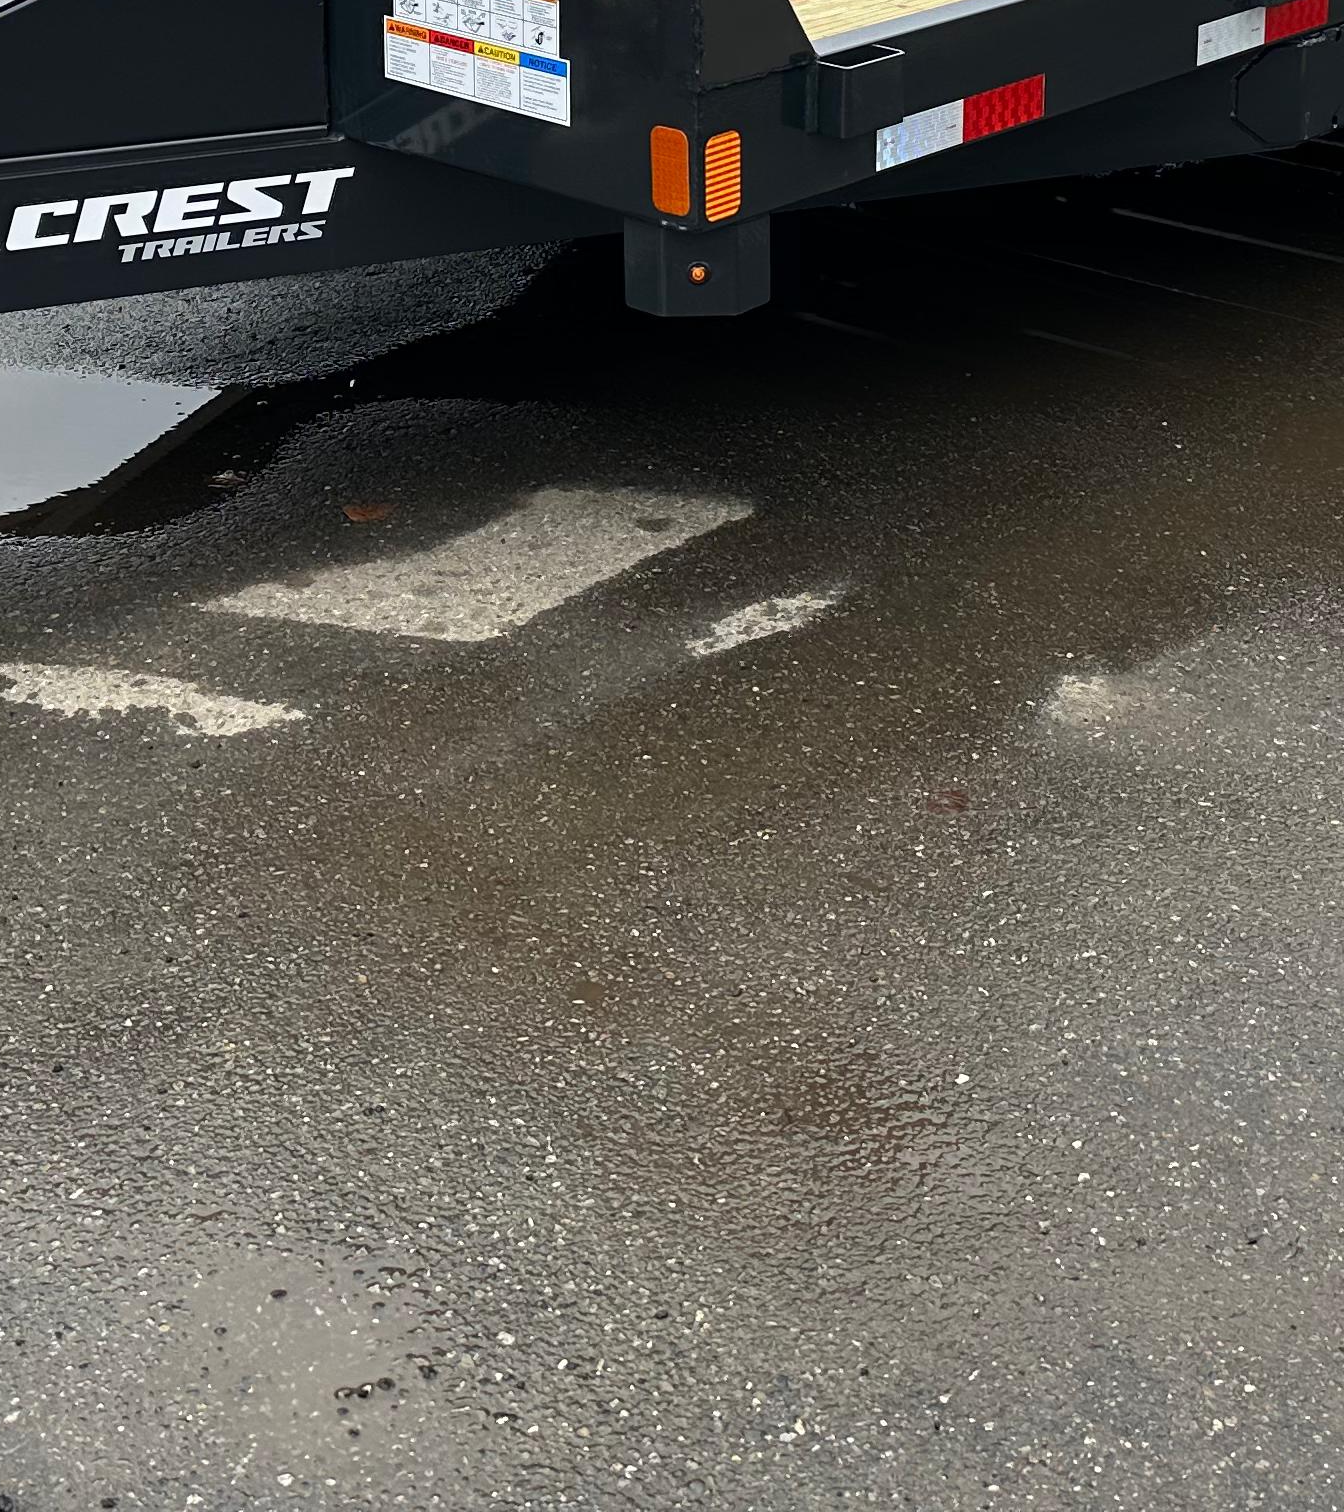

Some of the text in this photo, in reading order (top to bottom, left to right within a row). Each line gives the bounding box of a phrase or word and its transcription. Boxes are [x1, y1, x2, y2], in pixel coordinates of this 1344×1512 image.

[484, 46, 516, 62] CAUTION
[528, 58, 558, 73] NOTICE
[116, 220, 327, 265] TRAILERS
